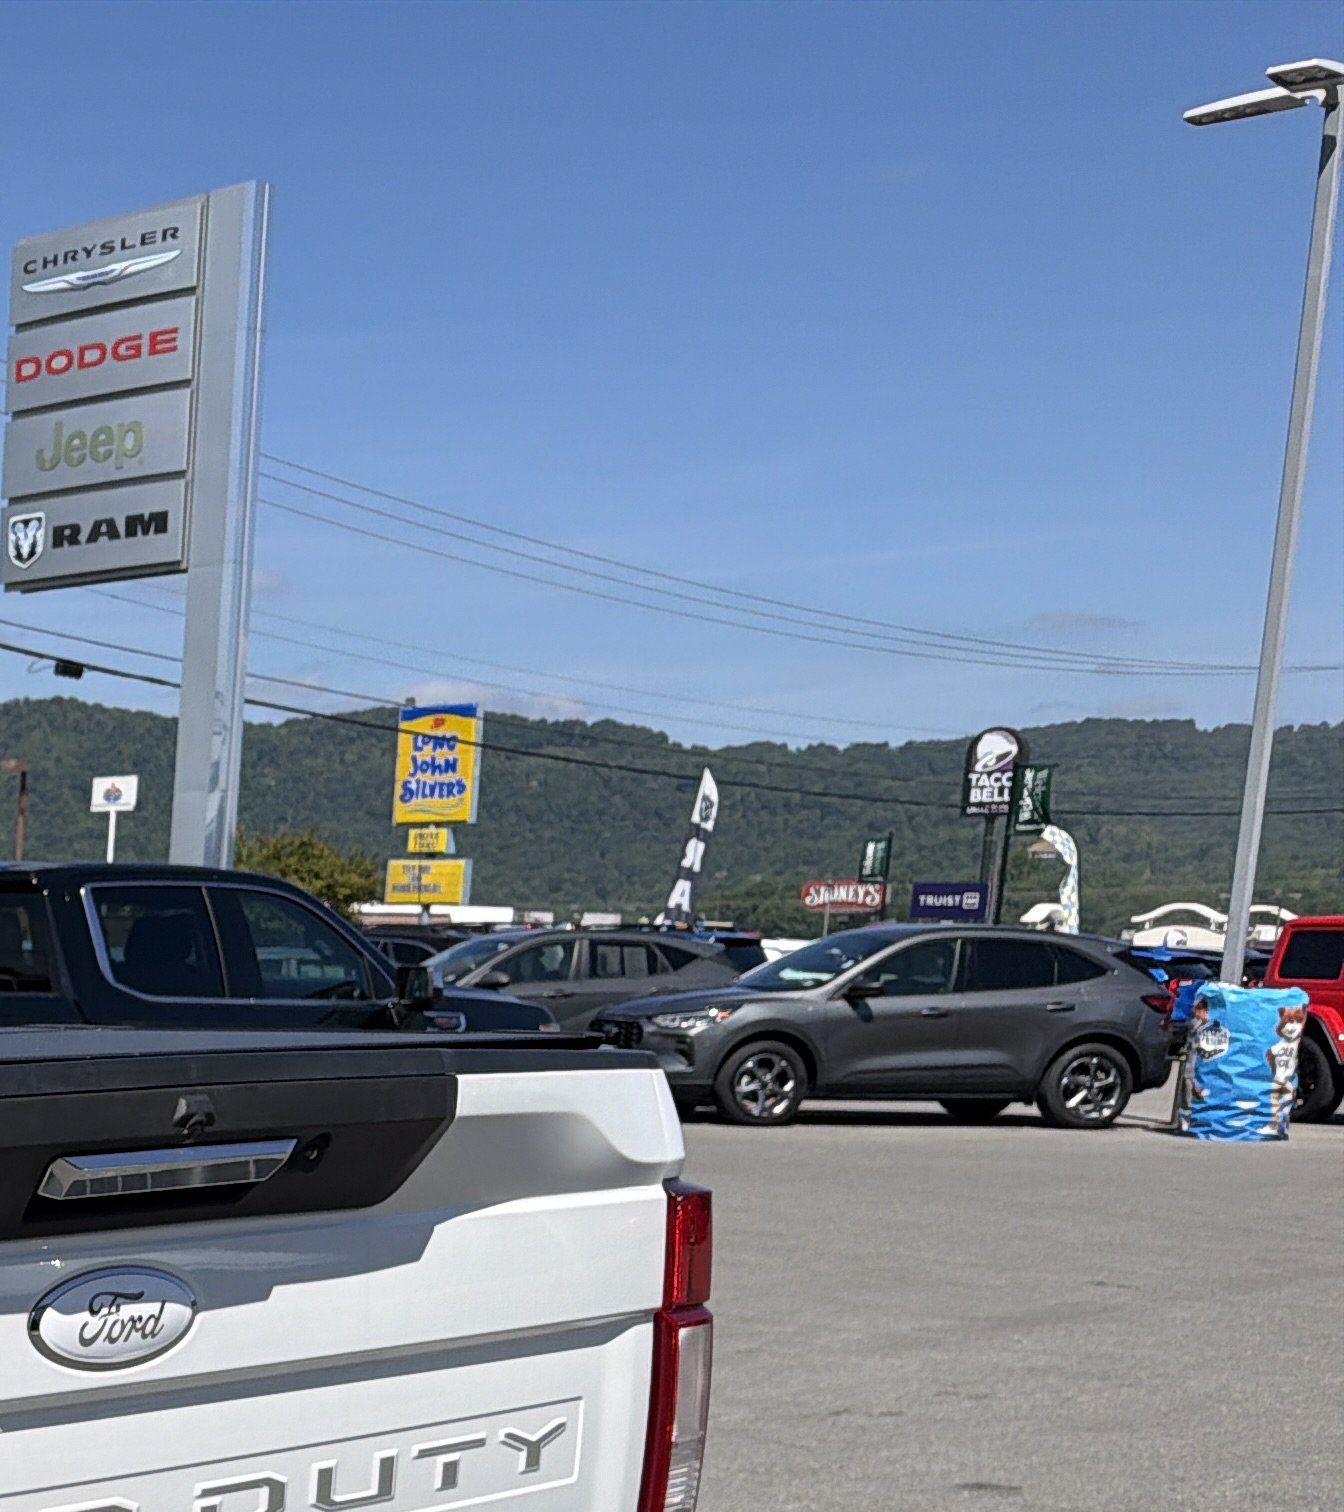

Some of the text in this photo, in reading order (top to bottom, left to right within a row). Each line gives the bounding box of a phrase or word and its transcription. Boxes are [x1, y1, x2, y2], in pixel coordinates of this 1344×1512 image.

[23, 226, 180, 275] CHRYSLER
[15, 327, 180, 385] DODGE
[35, 420, 144, 472] Jeep
[51, 510, 169, 549] RAM
[918, 894, 962, 907] TRUIST
[78, 1290, 167, 1348] Ford
